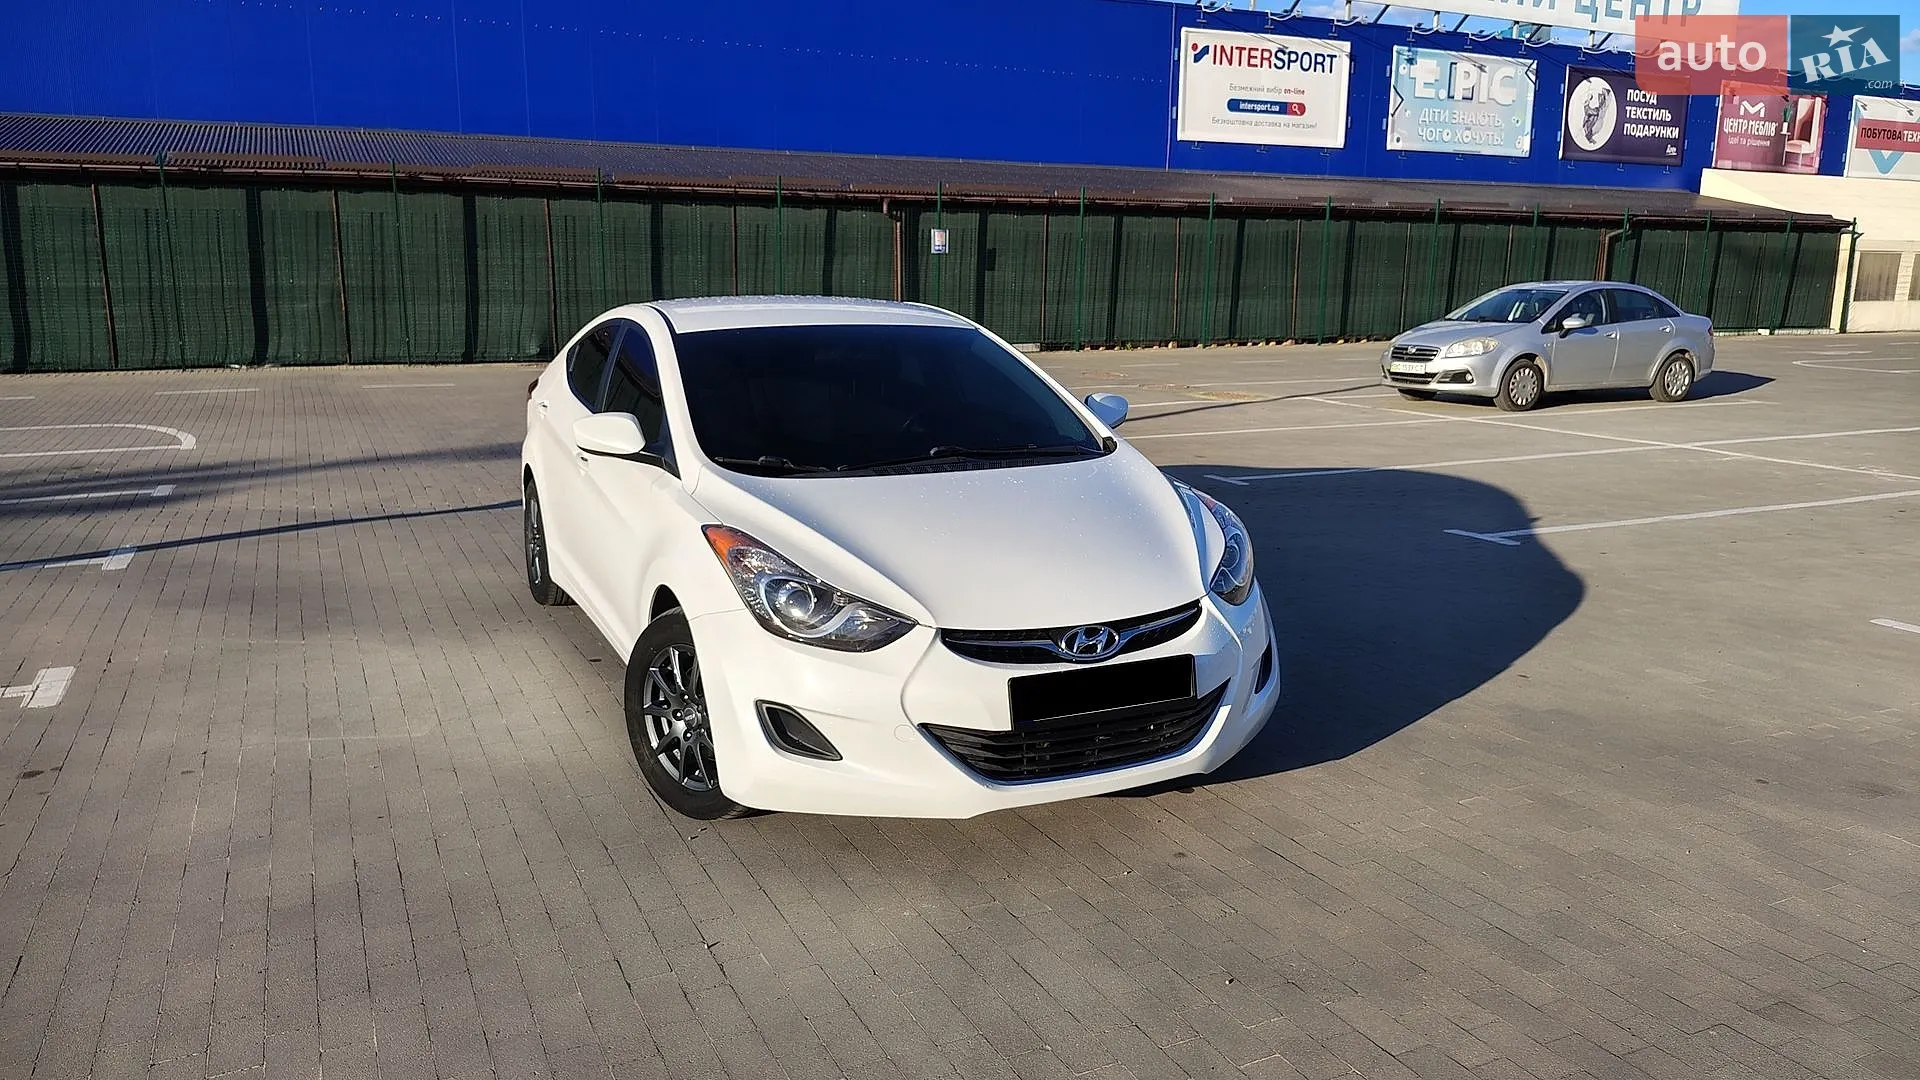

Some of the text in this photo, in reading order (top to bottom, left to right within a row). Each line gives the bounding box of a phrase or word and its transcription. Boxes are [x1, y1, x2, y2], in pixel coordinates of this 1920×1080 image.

[1212, 45, 1337, 74] INTERSPORT
[1229, 83, 1305, 96] Безмежний вибір on-line
[1627, 89, 1657, 105] ПОСУД
[1239, 101, 1280, 112] intersport.ua
[1625, 106, 1672, 122] ТЕКСТИЛЬ
[1254, 119, 1282, 128] доставка
[1419, 108, 1449, 125] ДІТИ
[1623, 124, 1680, 140] ПОДАРУНКИ
[1723, 117, 1776, 137] ЦЕНТР МЕБЛІВ
[1860, 127, 1902, 140] ПОБУТОВА
[1418, 128, 1505, 146] ЧОГО ХОЧУТЬ!
